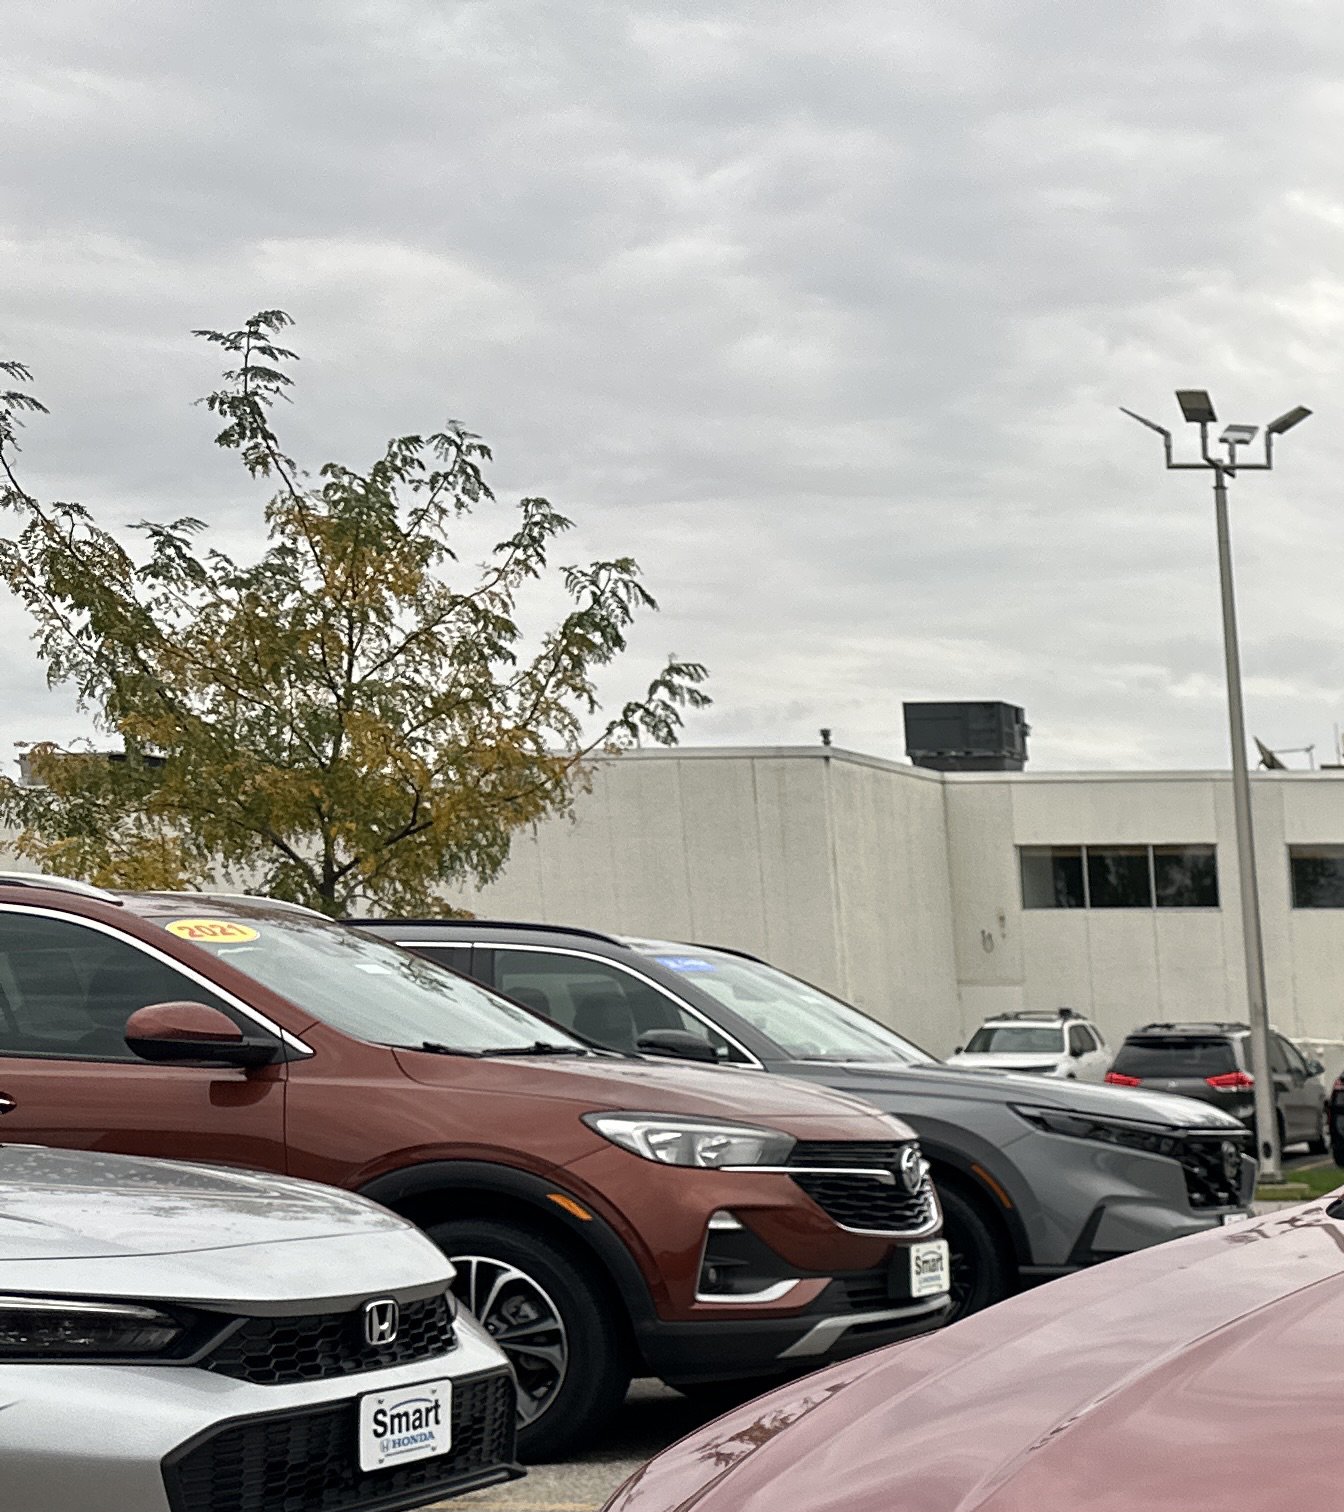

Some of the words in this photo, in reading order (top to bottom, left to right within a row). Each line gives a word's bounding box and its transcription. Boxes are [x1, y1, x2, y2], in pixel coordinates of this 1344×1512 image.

[176, 923, 248, 939] 2021
[372, 1398, 441, 1439] Smart
[391, 1430, 436, 1449] HONDA
